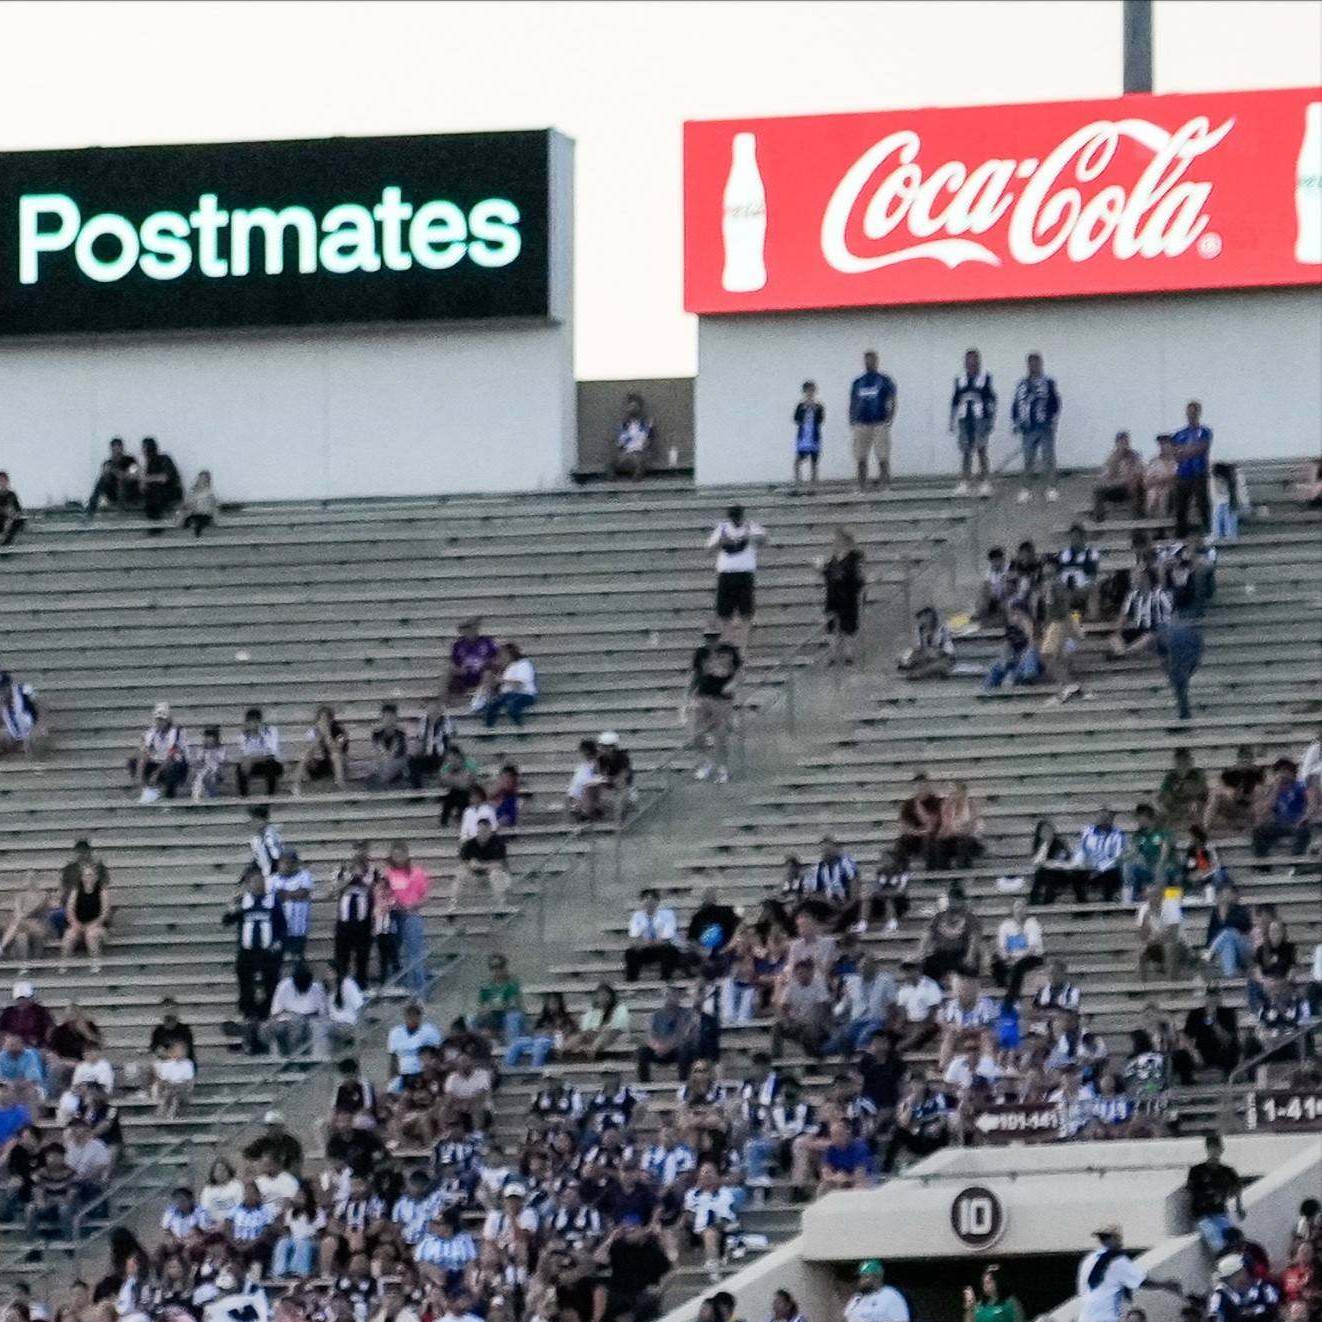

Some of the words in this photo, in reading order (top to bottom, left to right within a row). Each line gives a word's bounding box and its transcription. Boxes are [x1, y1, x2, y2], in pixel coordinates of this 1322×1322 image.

[18, 186, 524, 285] Postmates
[820, 114, 1237, 274] Coca-Cola
[958, 1197, 994, 1236] 10
